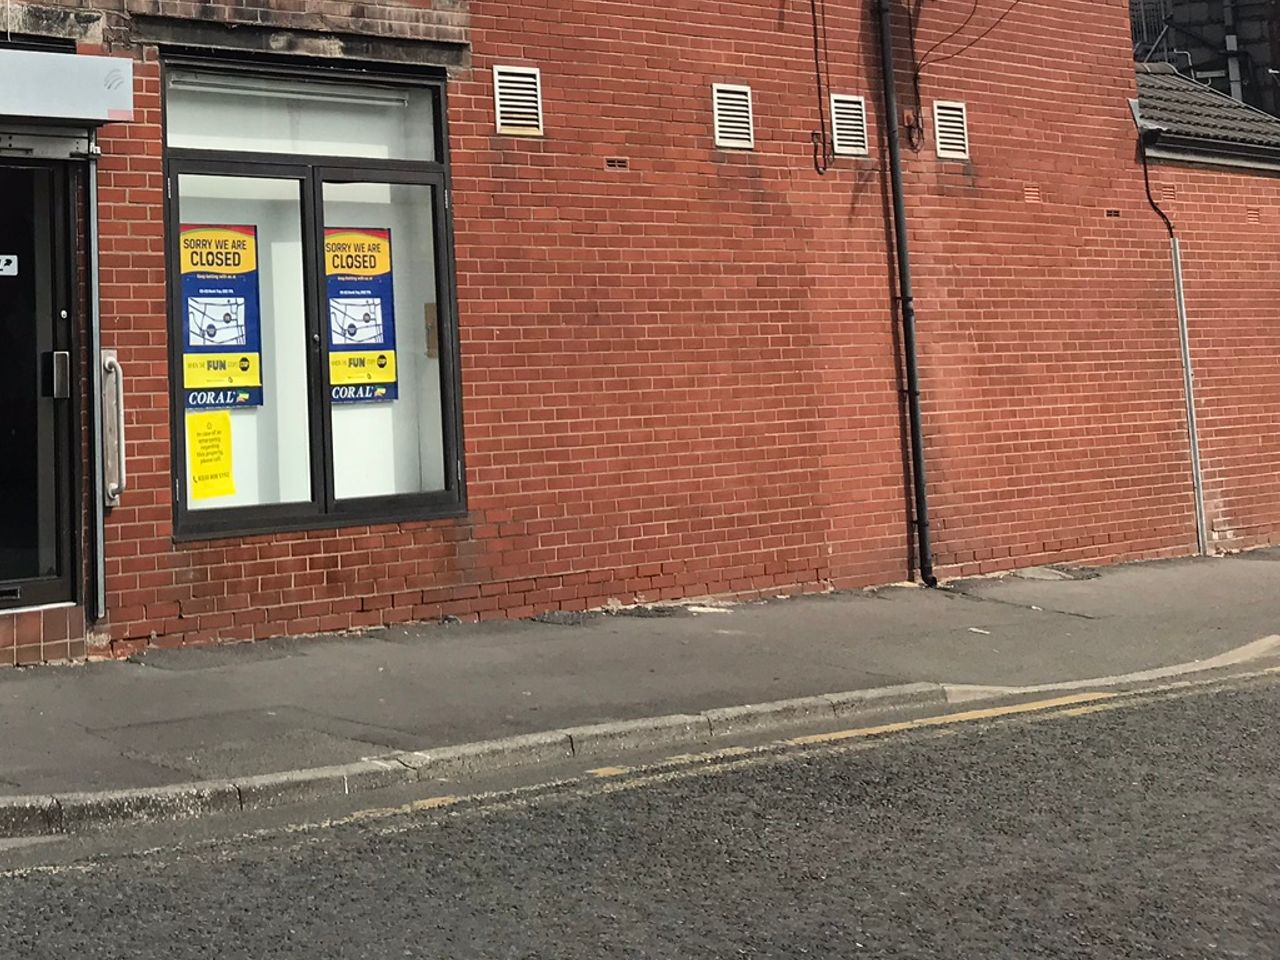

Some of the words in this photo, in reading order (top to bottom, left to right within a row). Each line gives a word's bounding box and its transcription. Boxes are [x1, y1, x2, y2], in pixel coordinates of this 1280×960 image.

[183, 239, 212, 249] SORRY
[215, 239, 229, 249] WE
[231, 239, 247, 250] ARE
[326, 243, 351, 253] SORRY
[353, 243, 366, 253] WE
[367, 243, 381, 253] ARE
[190, 251, 241, 267] CLOSED
[332, 254, 376, 269] CLOSED
[207, 360, 226, 371] FUN
[348, 357, 365, 368] FUN
[188, 391, 234, 405] CORAL
[331, 386, 373, 399] CORAL
